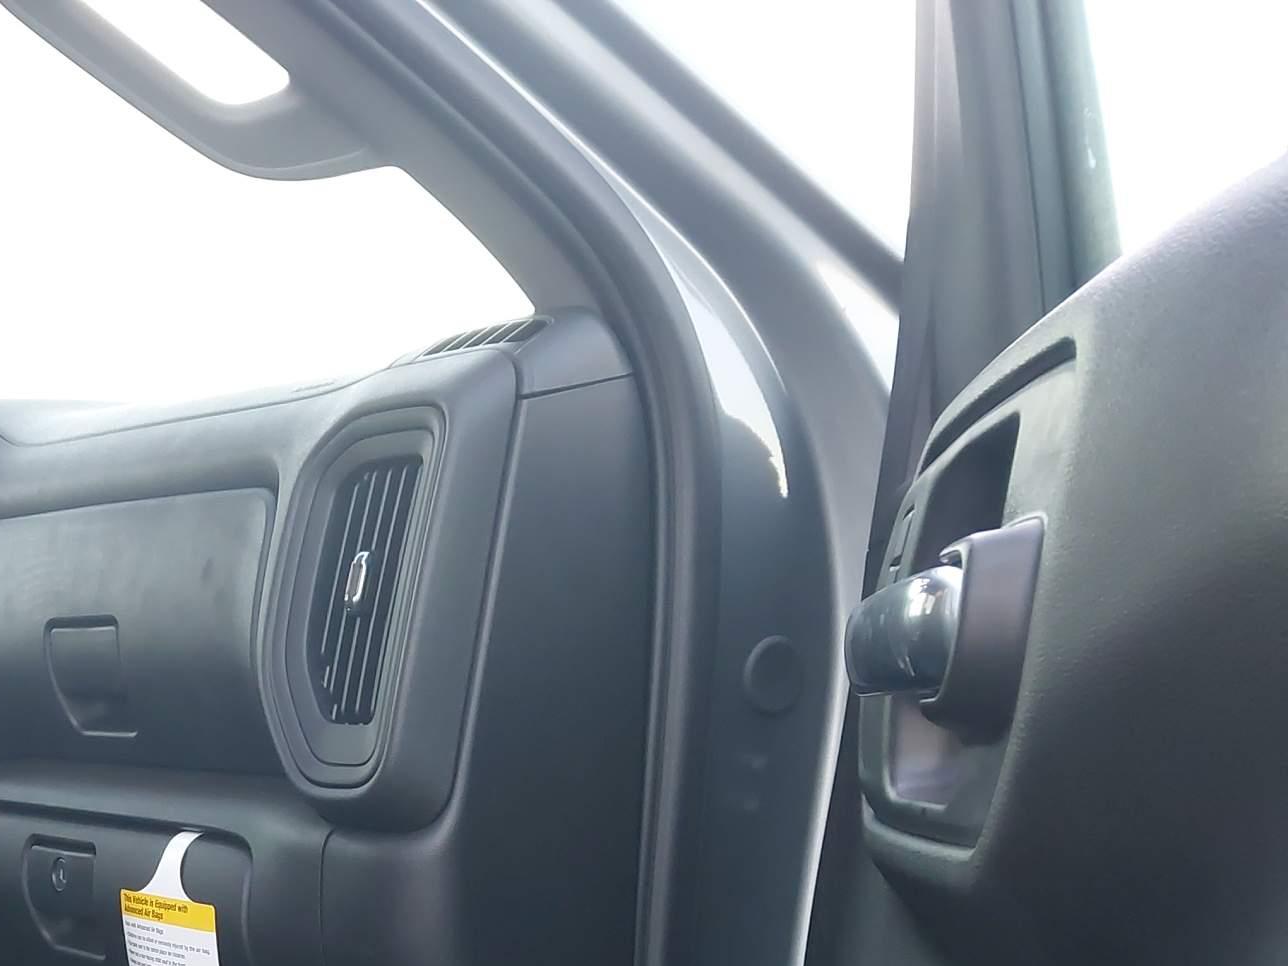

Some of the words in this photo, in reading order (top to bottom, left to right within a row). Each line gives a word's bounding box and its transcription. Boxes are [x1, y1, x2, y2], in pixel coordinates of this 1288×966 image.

[133, 895, 149, 906] Vehicle
[155, 899, 177, 912] Equipped
[178, 903, 189, 914] with
[151, 910, 164, 920] Bags
